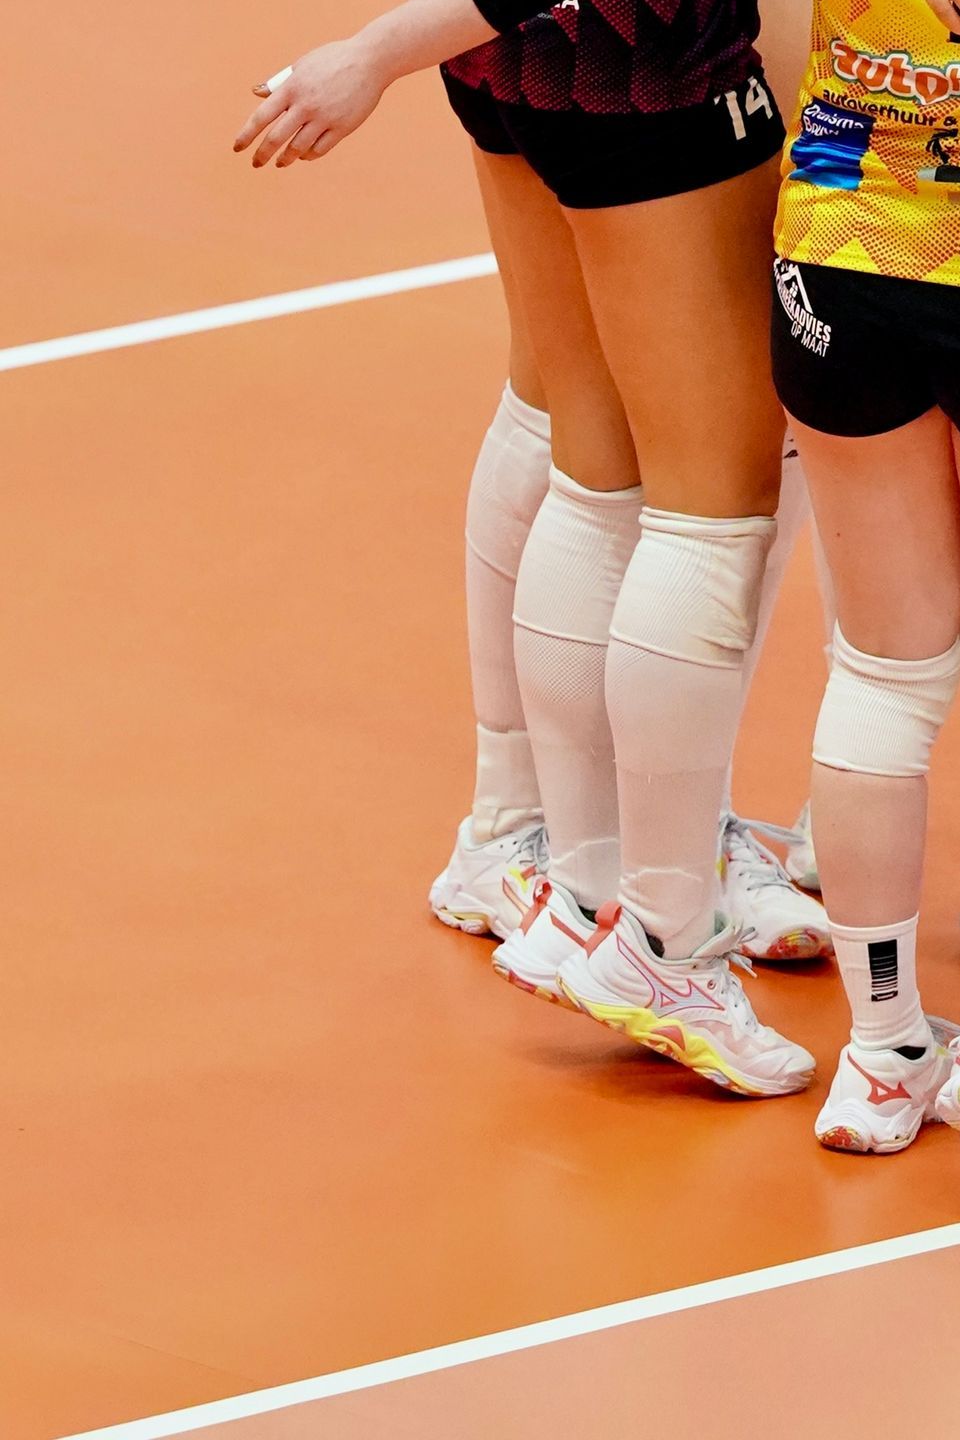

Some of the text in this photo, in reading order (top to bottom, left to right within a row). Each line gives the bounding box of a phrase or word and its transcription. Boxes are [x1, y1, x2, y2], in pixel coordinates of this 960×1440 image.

[713, 74, 774, 141] 14
[822, 88, 938, 127] autoverhuur
[943, 115, 958, 127] &
[800, 330, 830, 358] MAAT
